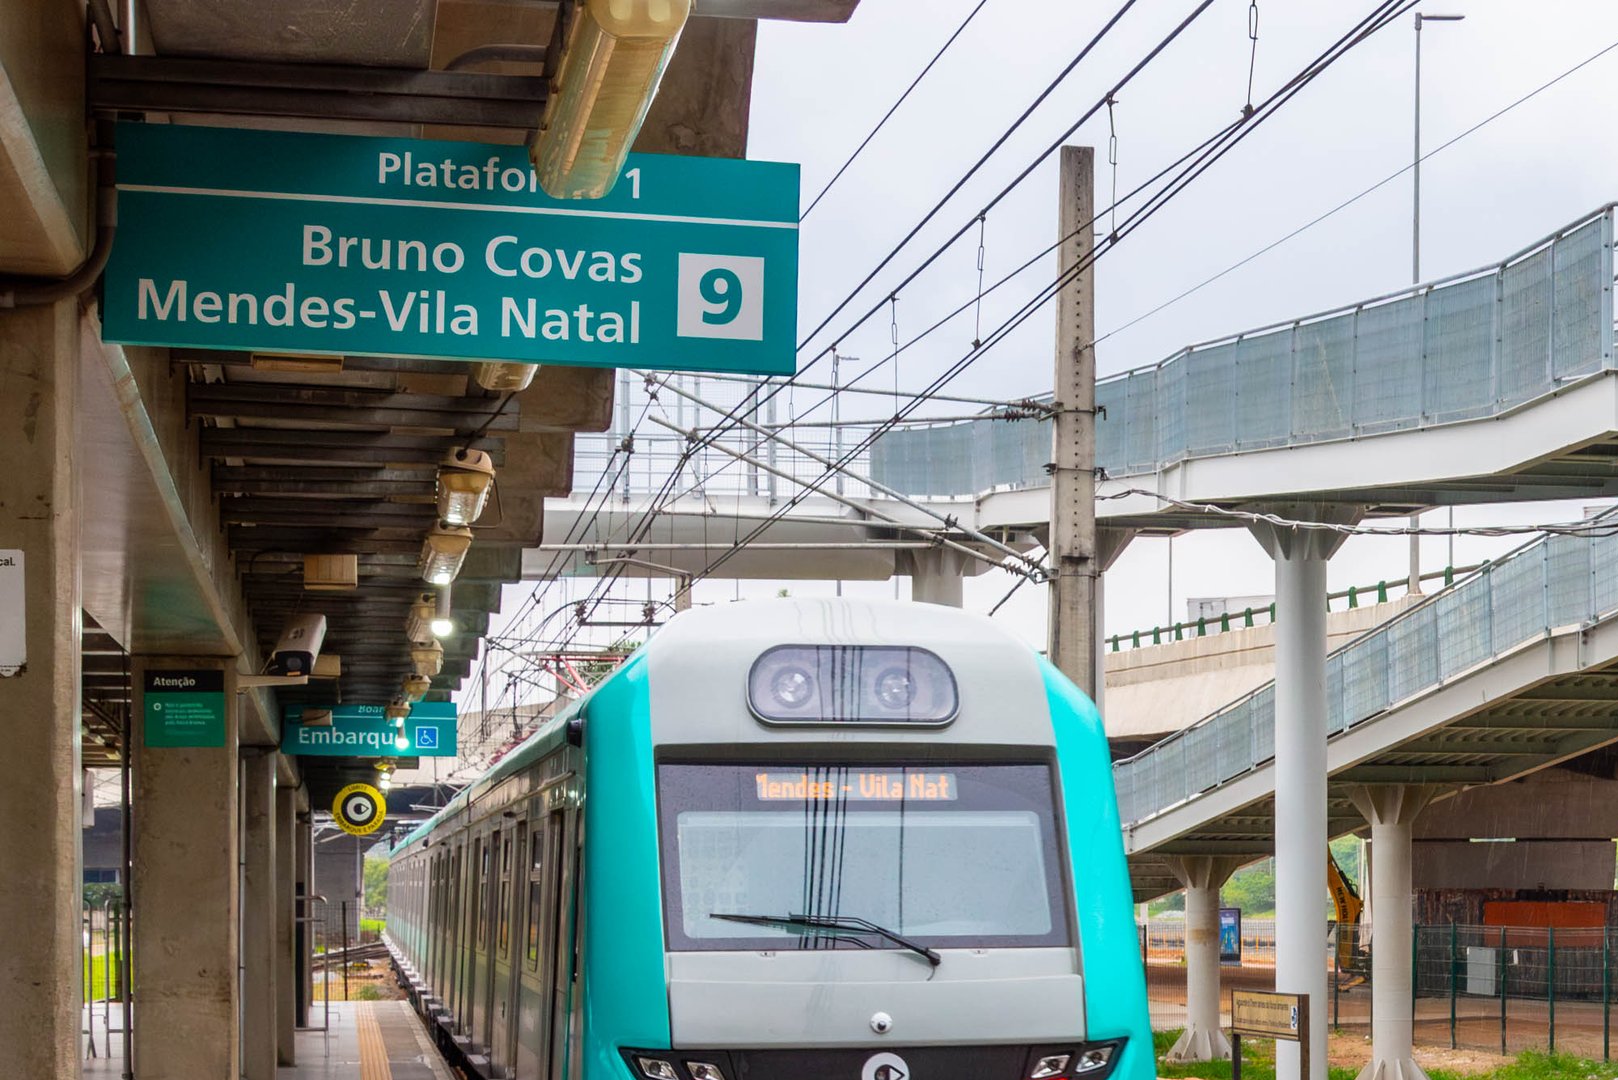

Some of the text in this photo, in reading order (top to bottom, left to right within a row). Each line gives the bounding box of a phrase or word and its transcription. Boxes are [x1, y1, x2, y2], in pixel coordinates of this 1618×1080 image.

[377, 151, 641, 199] Platafor 1
[302, 224, 643, 284] Bruno Covas
[137, 278, 640, 344] Mendes-Vila Natal
[699, 267, 743, 326] 9
[153, 676, 196, 689] Atenção
[859, 773, 904, 799] Vila
[909, 773, 949, 799] Nat
